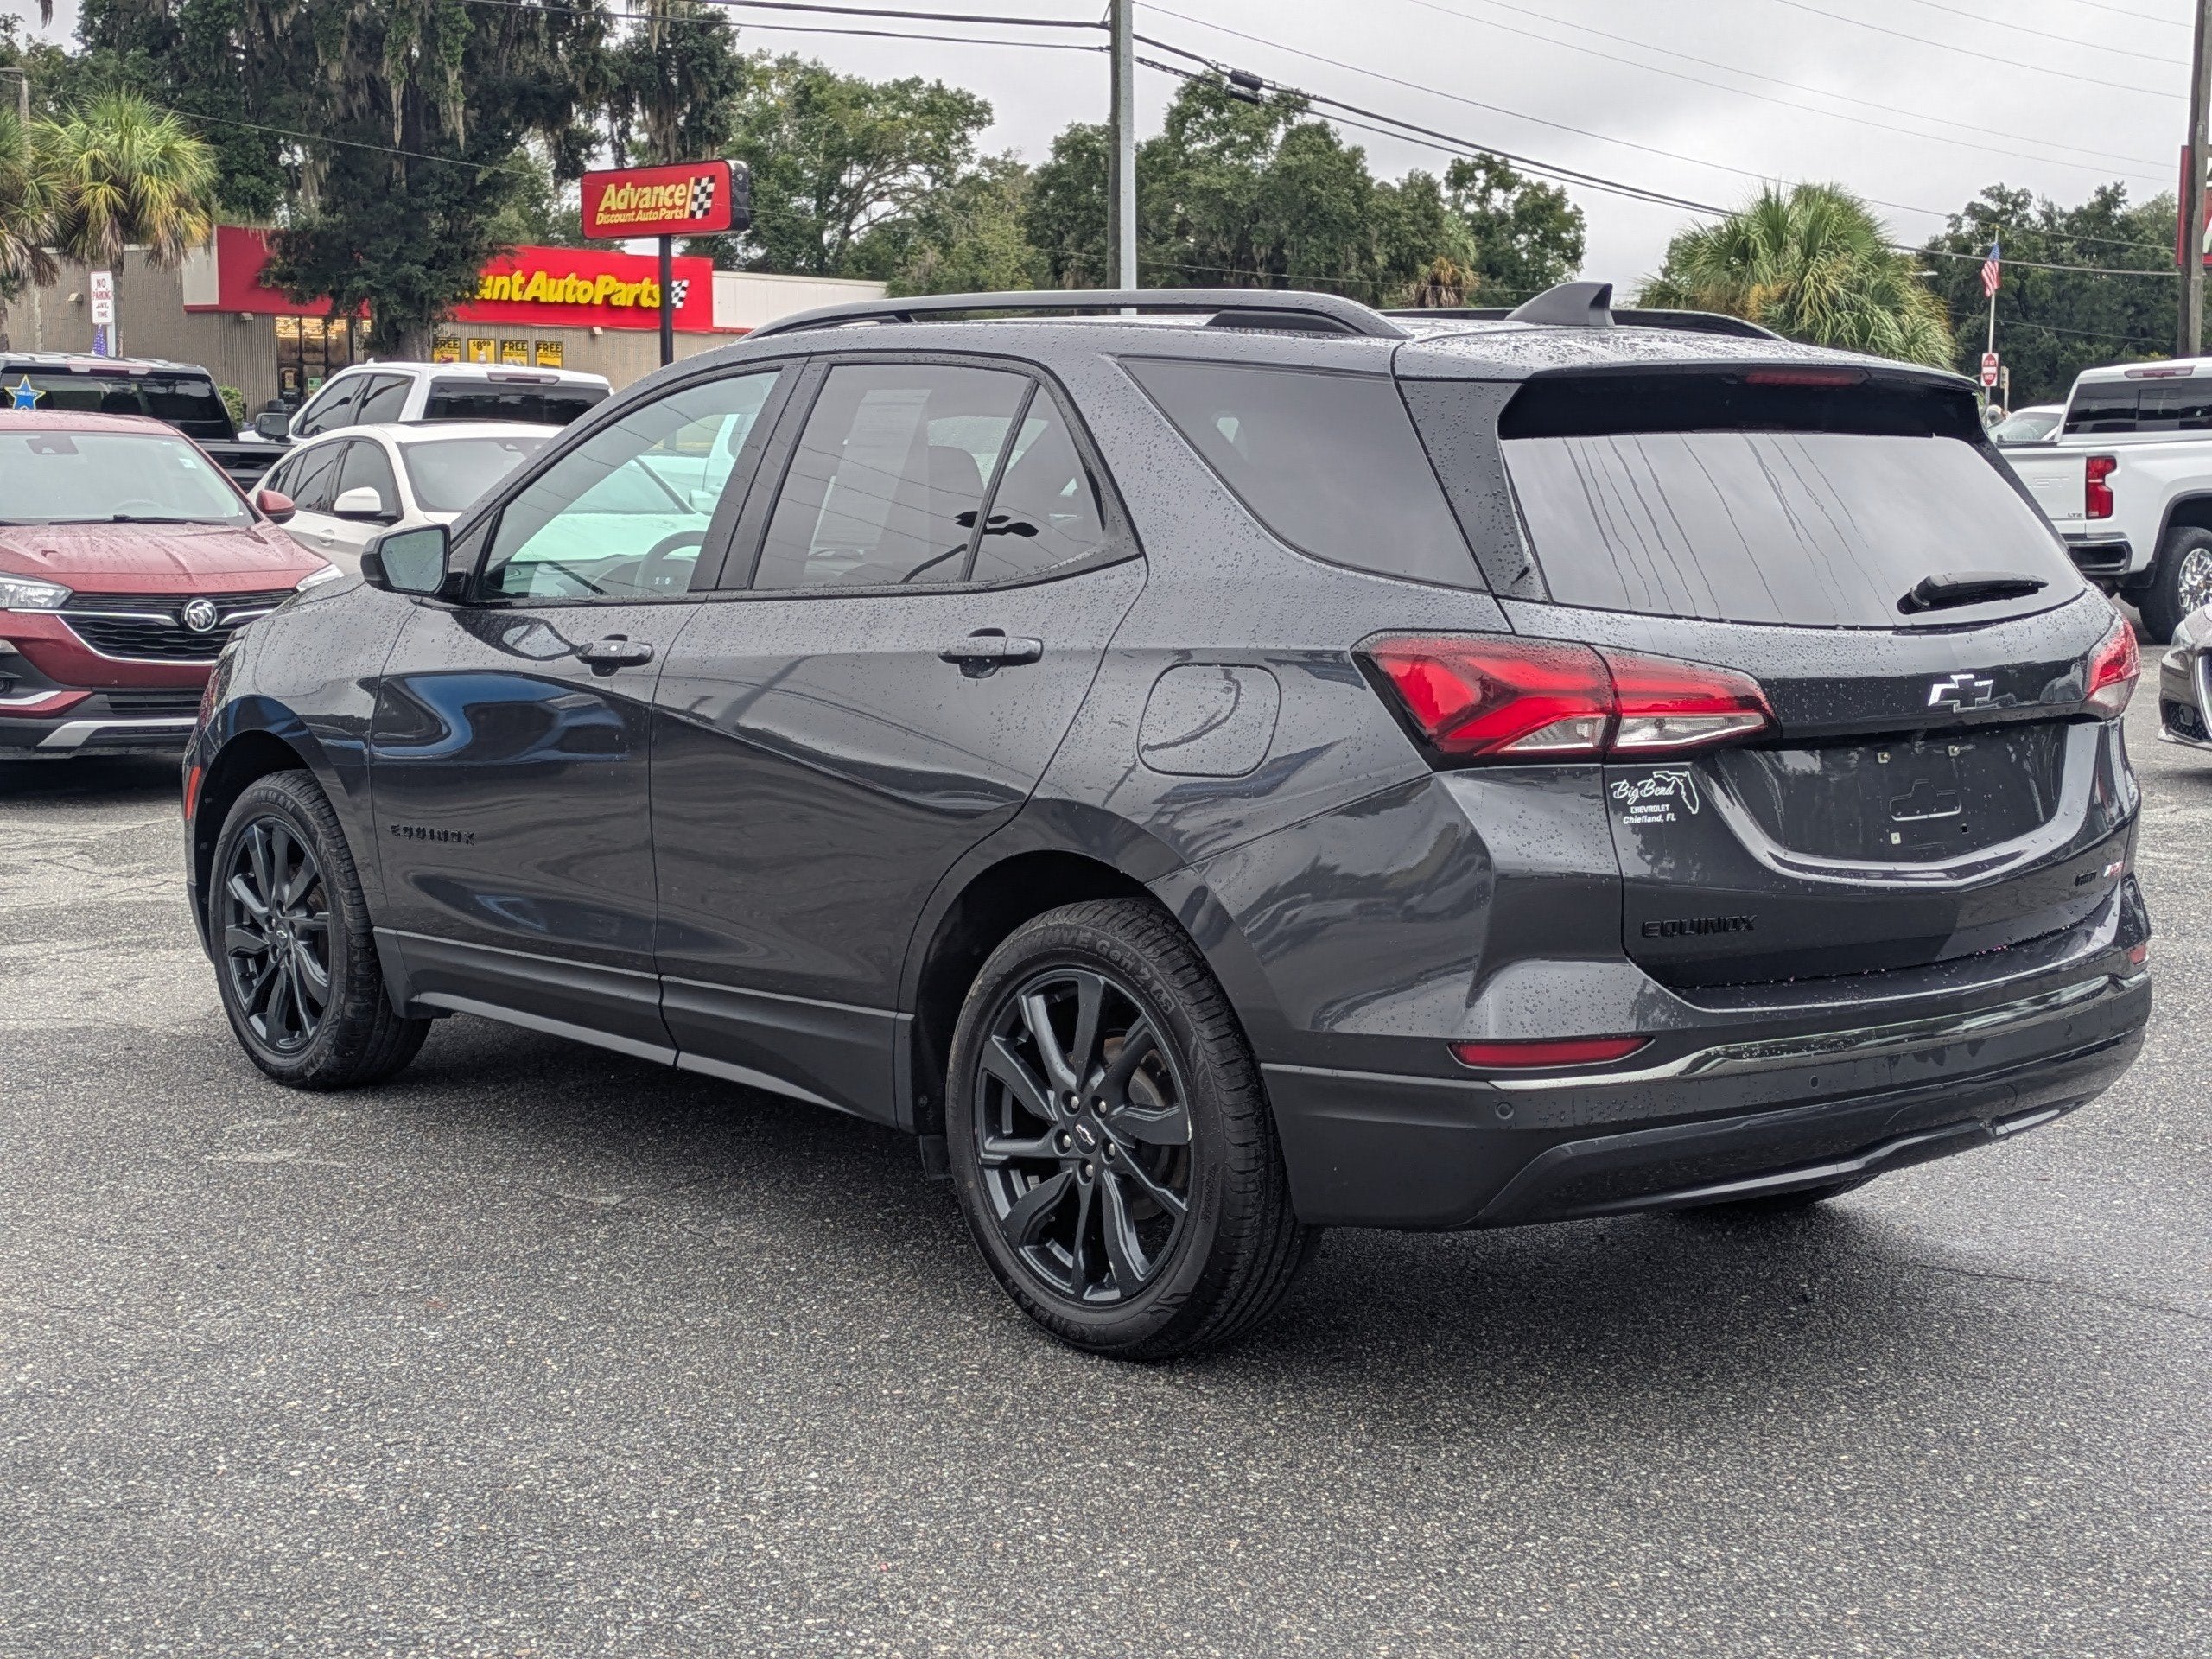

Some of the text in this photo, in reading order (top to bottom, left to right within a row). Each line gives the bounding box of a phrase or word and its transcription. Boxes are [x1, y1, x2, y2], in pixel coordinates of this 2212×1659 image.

[598, 181, 687, 213] Advance
[595, 207, 684, 226] Discount Auto Parts
[96, 278, 106, 289] NO
[523, 270, 594, 304] Auto
[503, 341, 527, 351] FREE
[537, 343, 562, 353] FREE
[1611, 778, 1675, 805] Big Bend
[1630, 804, 1670, 814] CHEVROLET
[1666, 813, 1676, 822] FL
[390, 824, 476, 846] EQUINOX
[1642, 914, 1758, 938] EQUINOX
